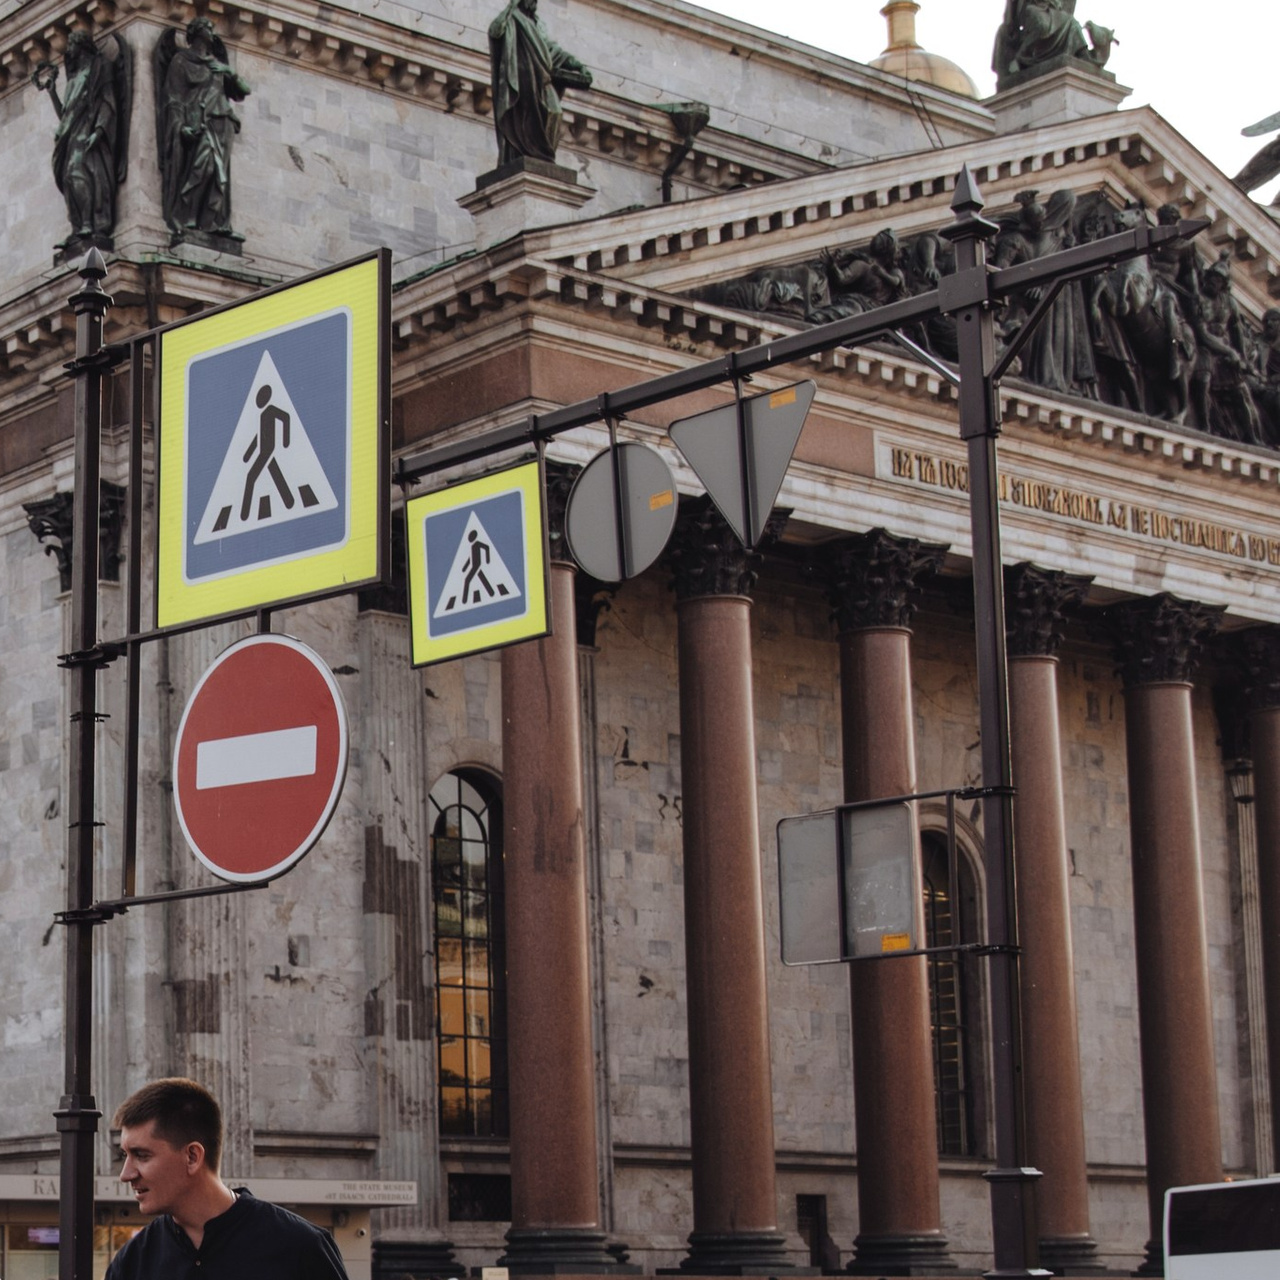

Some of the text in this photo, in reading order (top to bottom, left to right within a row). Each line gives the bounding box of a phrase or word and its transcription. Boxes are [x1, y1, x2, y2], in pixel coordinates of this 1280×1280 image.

[892, 448, 914, 479] НА
[1107, 502, 1128, 531] ДА
[1131, 507, 1149, 534] НЕ
[1249, 534, 1266, 562] ВО
[343, 1183, 358, 1191] THE
[359, 1183, 381, 1191] STATE
